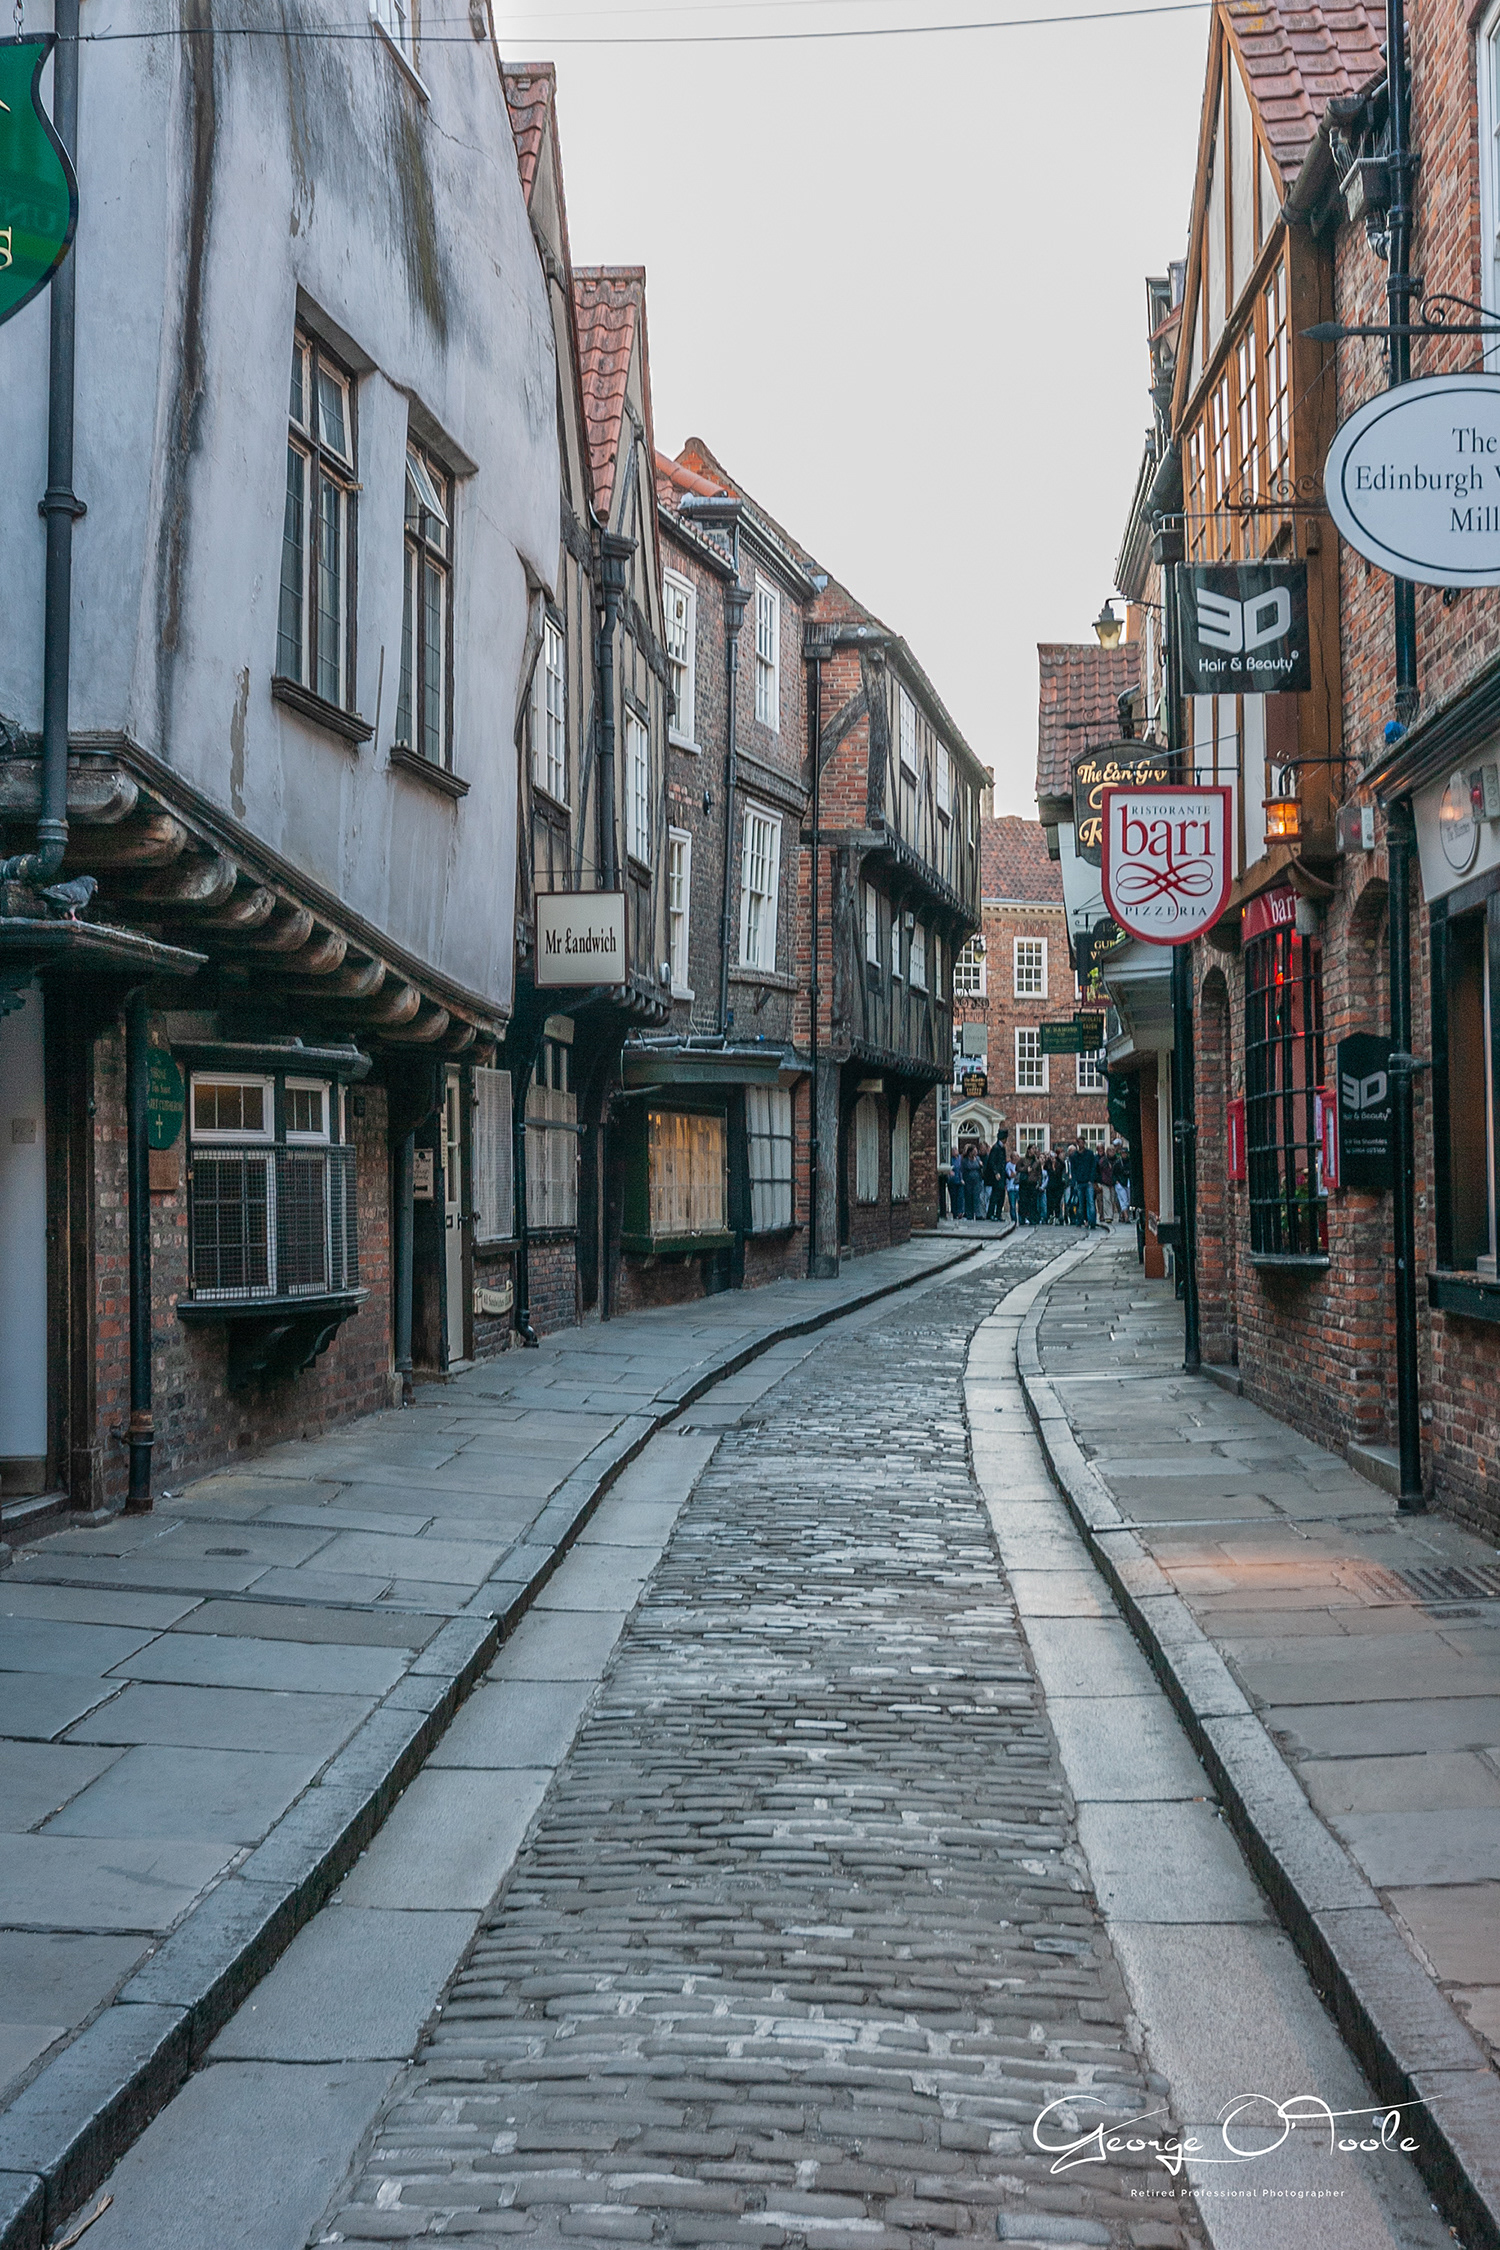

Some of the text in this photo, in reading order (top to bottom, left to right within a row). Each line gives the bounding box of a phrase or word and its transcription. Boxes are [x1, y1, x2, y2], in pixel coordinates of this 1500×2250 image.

[1451, 426, 1498, 453] The
[1354, 463, 1484, 498] Edinburgh
[1449, 505, 1500, 532] Mill
[1196, 585, 1291, 654] 3D
[1199, 656, 1293, 673] Hair & Beauty
[1077, 760, 1102, 785] The
[1102, 760, 1133, 783] Earl
[1131, 805, 1211, 816] RISTORANTE
[1116, 803, 1216, 858] bari
[1125, 905, 1208, 917] PIZZERIA
[545, 928, 562, 955] Mr
[1342, 1070, 1388, 1110] 3D
[1361, 1111, 1389, 1122] Beauty
